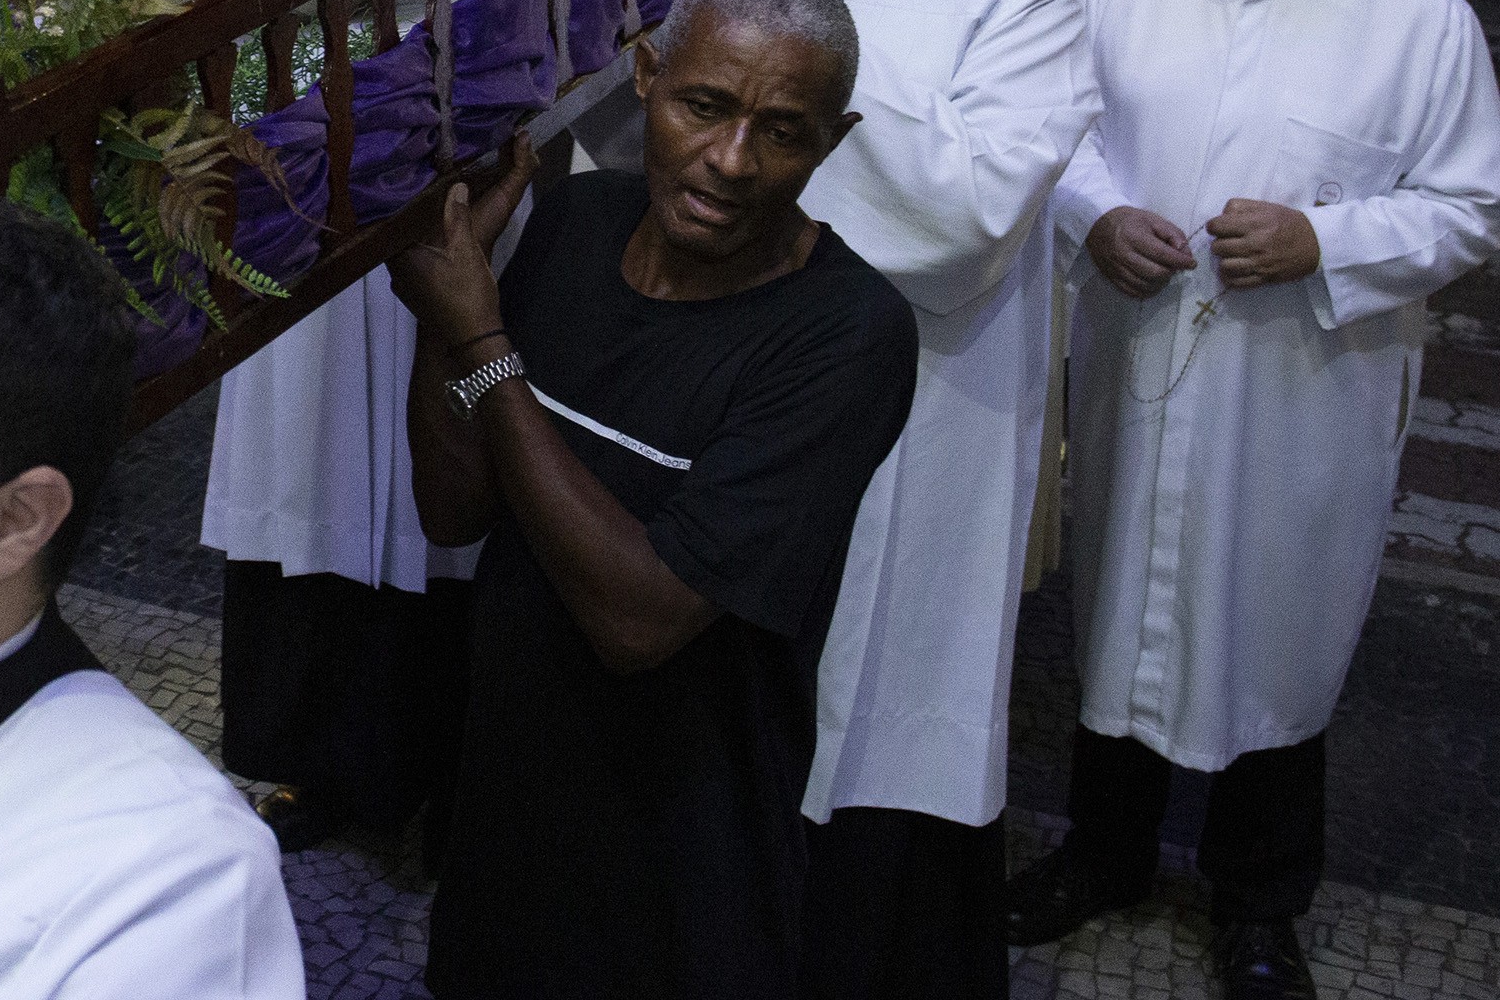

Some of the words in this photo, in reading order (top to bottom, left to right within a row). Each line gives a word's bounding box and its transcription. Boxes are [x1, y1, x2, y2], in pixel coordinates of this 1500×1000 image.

[616, 432, 638, 450] Calvin
[638, 442, 659, 461] Klein
[659, 454, 692, 470] Jeans
